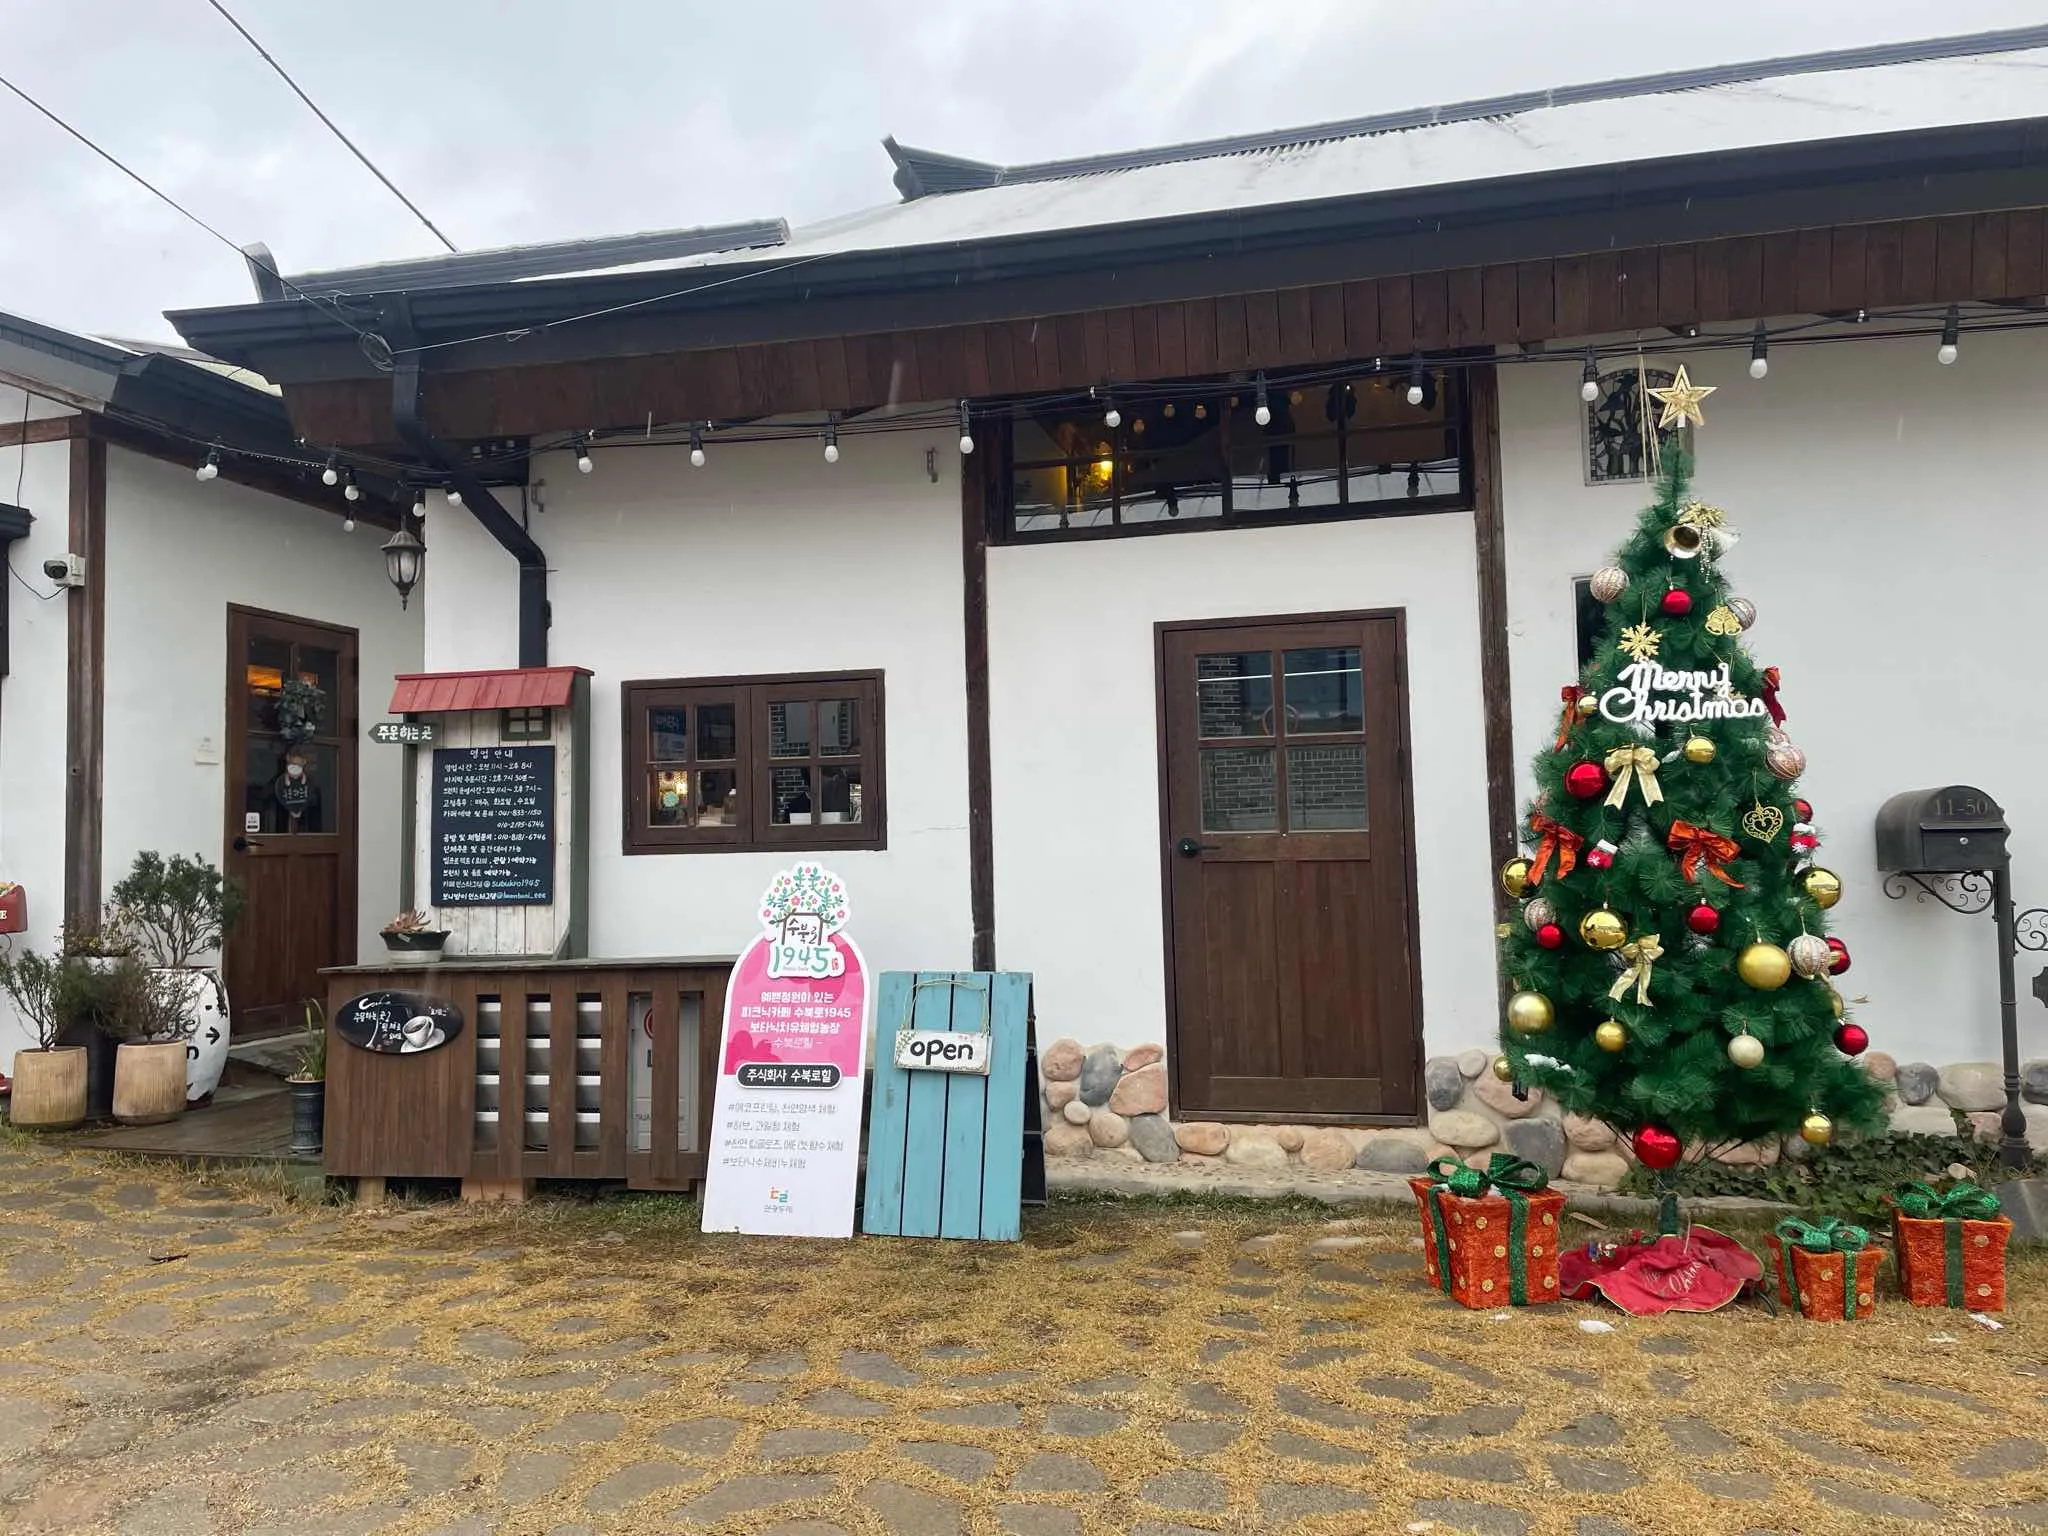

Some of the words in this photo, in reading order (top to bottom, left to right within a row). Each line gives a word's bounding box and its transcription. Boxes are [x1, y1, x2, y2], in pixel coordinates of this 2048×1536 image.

[1617, 659, 1732, 699] Merry
[1599, 687, 1766, 723] Christmas
[421, 725, 433, 740] 곳
[470, 749, 489, 759] 영업
[494, 749, 513, 759] 안내
[1935, 798, 1988, 816] 11-50
[787, 917, 818, 945] 수북로
[773, 945, 831, 973] 1945
[814, 991, 834, 1004] 있는
[741, 1007, 791, 1019] 피크닉카페
[910, 1039, 974, 1066] open
[747, 1068, 788, 1082] 주식회사
[791, 1068, 832, 1083] 수북로힐
